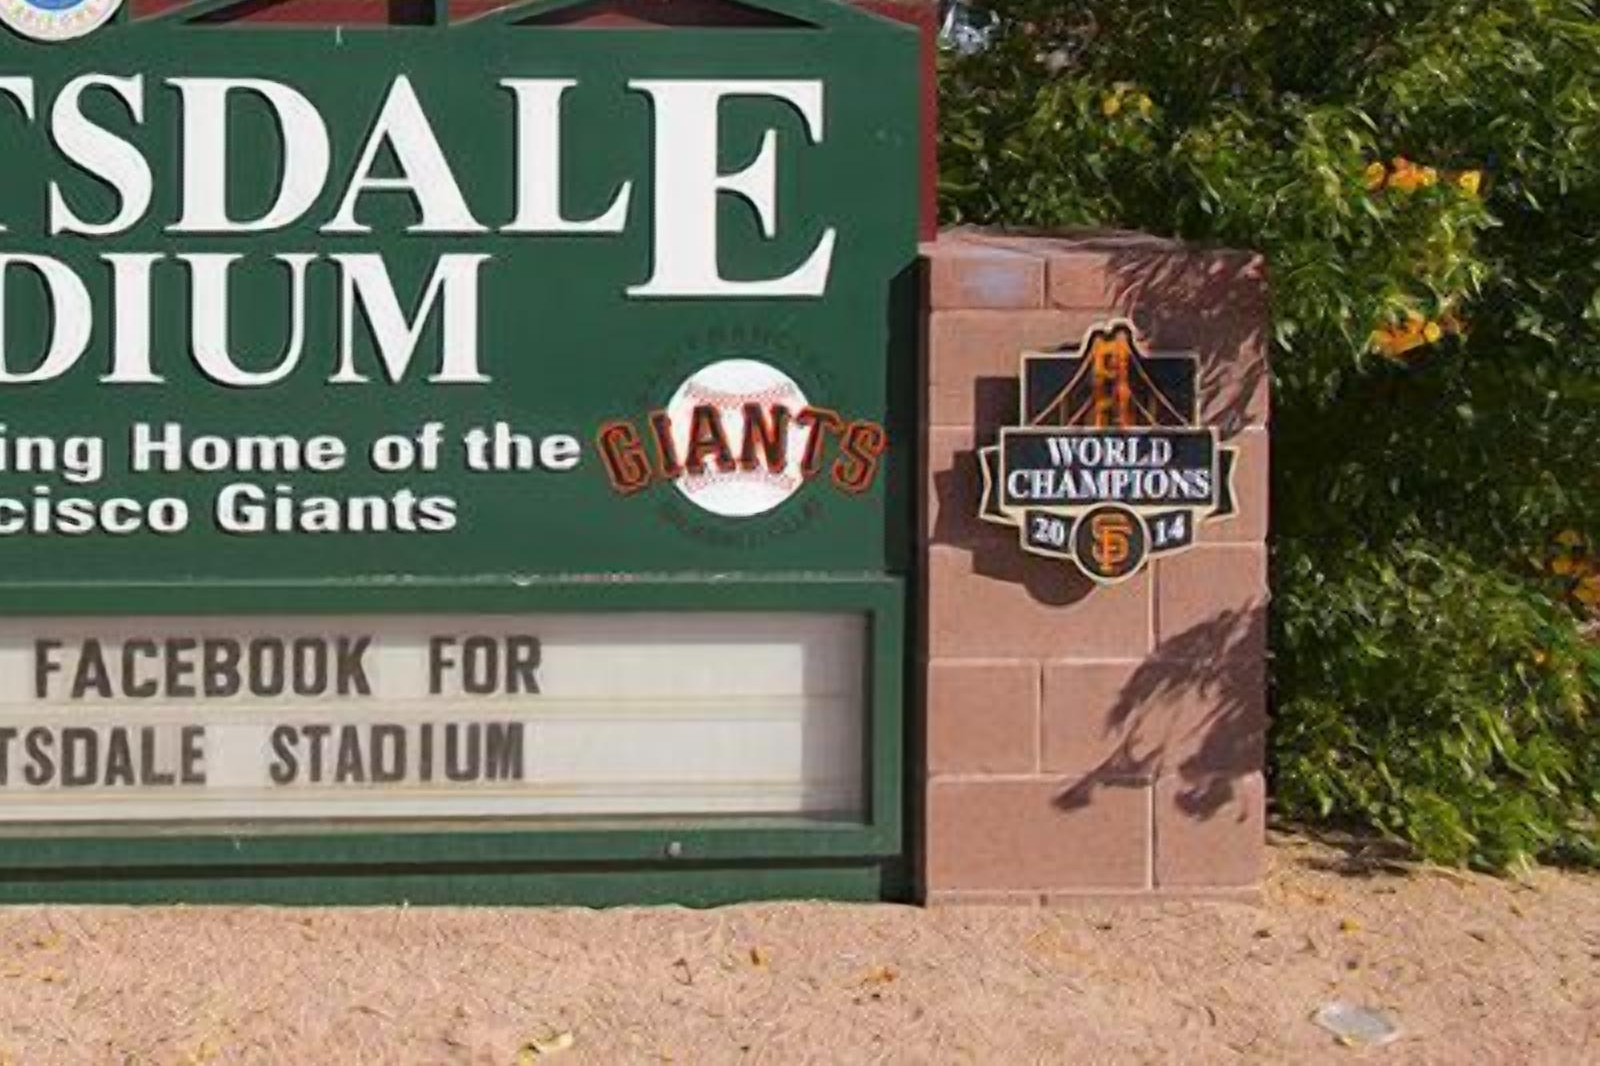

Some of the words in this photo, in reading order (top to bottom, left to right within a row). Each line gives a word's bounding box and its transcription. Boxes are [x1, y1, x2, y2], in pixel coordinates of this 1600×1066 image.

[134, 423, 347, 471] Home
[373, 422, 444, 471] of
[463, 421, 582, 471] the
[598, 401, 887, 493] GIANTS
[1047, 437, 1173, 467] WORLD
[217, 484, 458, 532] Giants
[1007, 469, 1210, 500] CHAMPIONS
[32, 637, 375, 699] FACEBOOK
[428, 635, 542, 695] FOR
[269, 722, 525, 786] STADIUM
